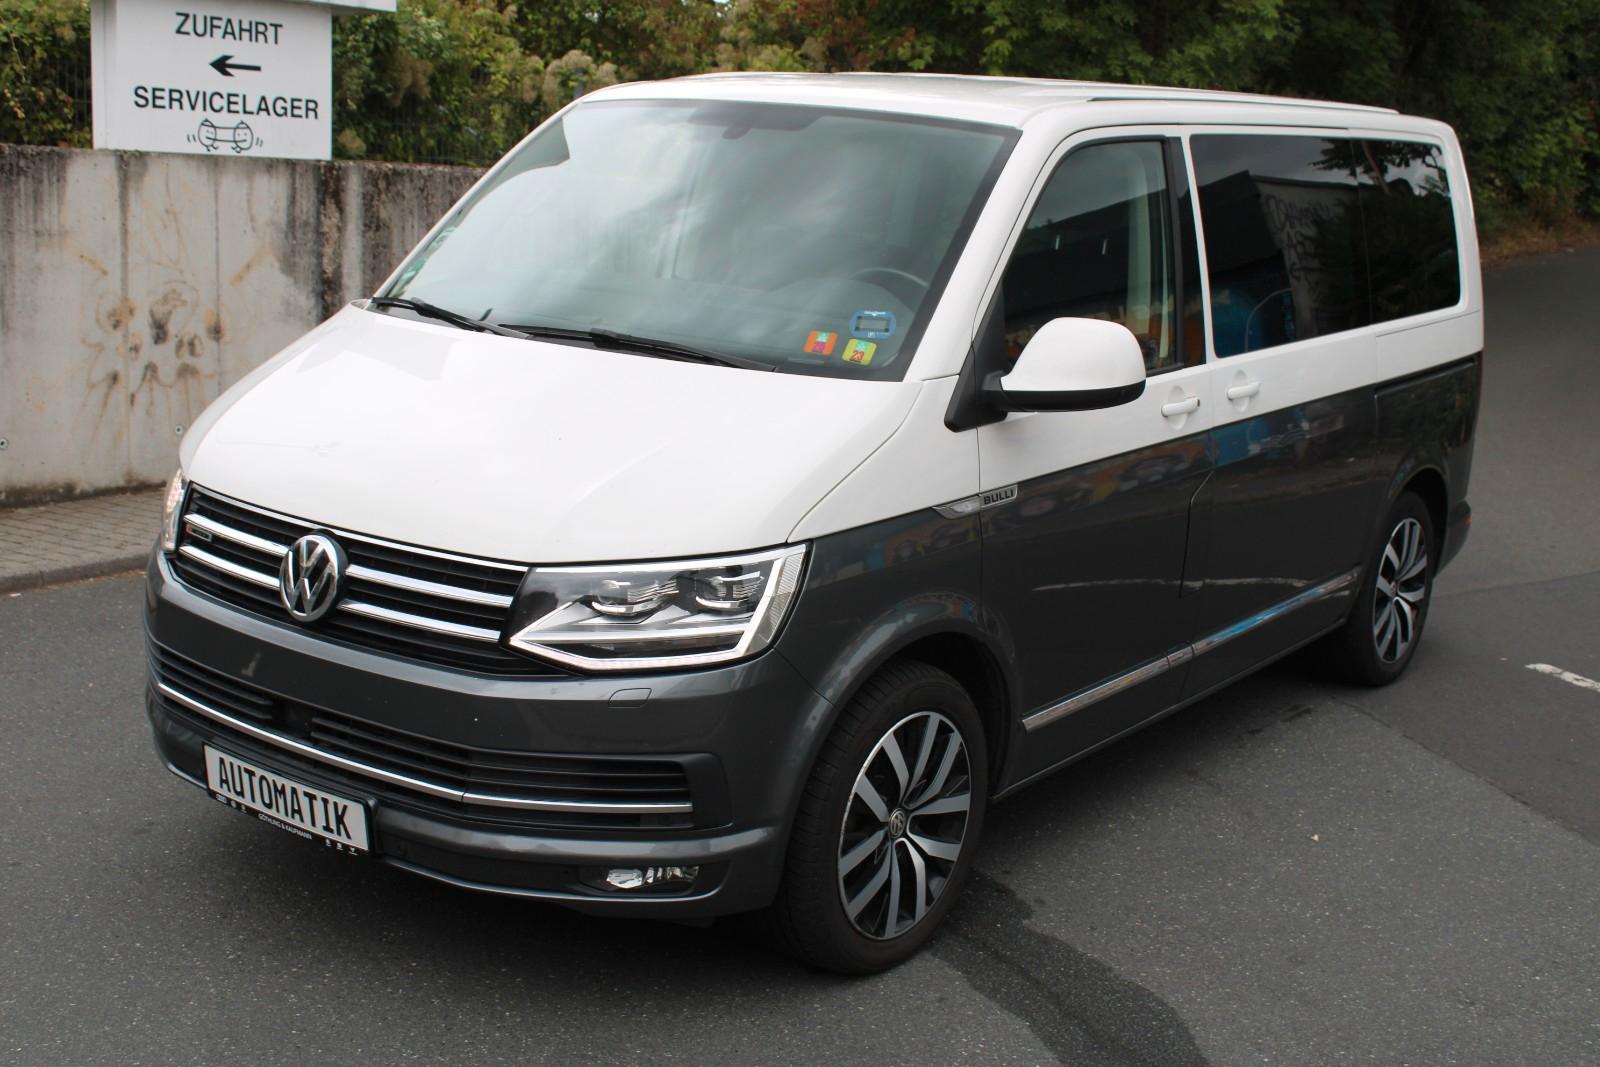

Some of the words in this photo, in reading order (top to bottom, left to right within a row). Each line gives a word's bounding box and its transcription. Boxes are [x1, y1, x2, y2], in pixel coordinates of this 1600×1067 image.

[175, 12, 283, 45] ZUFAHRT
[133, 86, 319, 119] SERVICELAGER
[983, 489, 1014, 505] BULLI
[218, 757, 352, 840] AUTOMATIK
